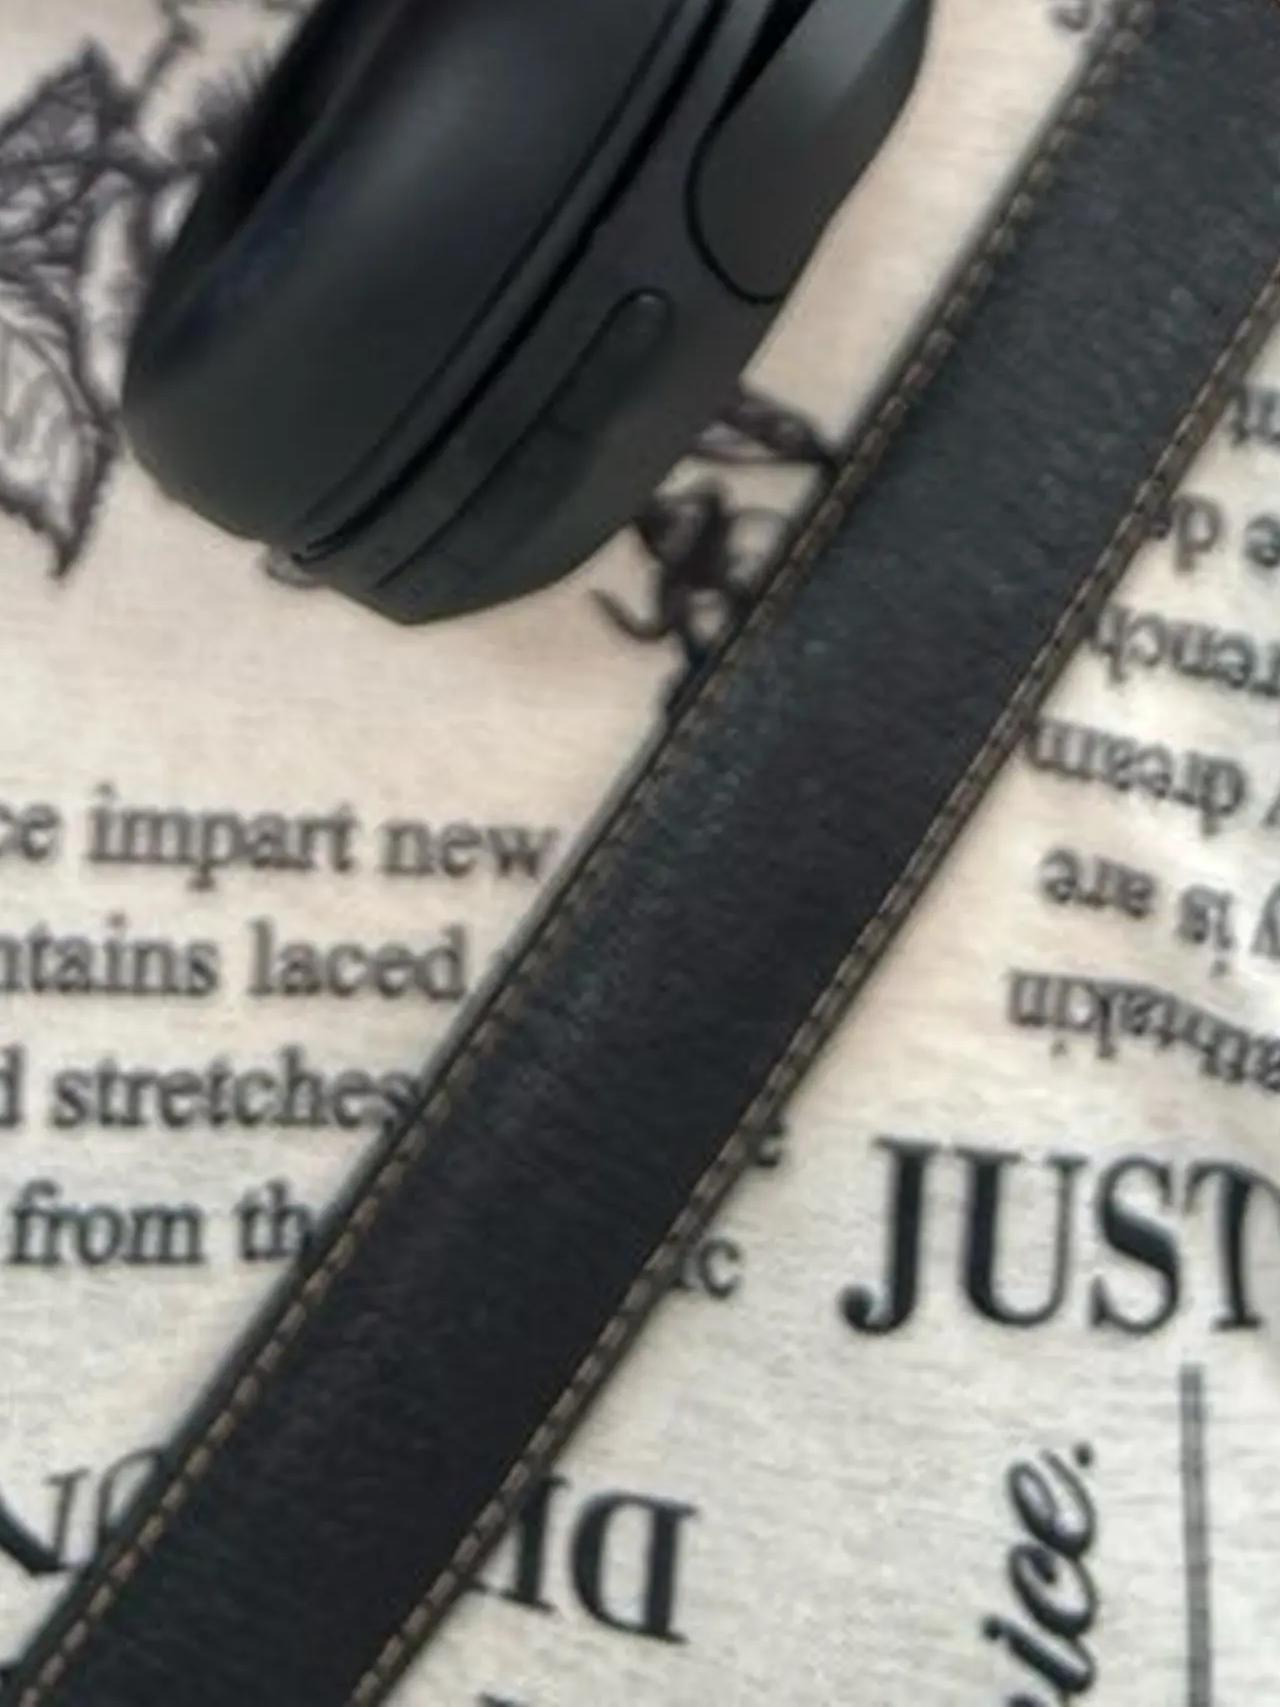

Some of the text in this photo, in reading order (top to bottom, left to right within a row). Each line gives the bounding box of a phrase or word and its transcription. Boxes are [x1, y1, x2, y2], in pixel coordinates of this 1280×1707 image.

[87, 783, 360, 889] impart
[382, 820, 562, 882] new
[1037, 846, 1160, 920] are
[247, 918, 472, 1003] laced
[7, 1181, 205, 1268] from
[236, 1176, 318, 1264] th
